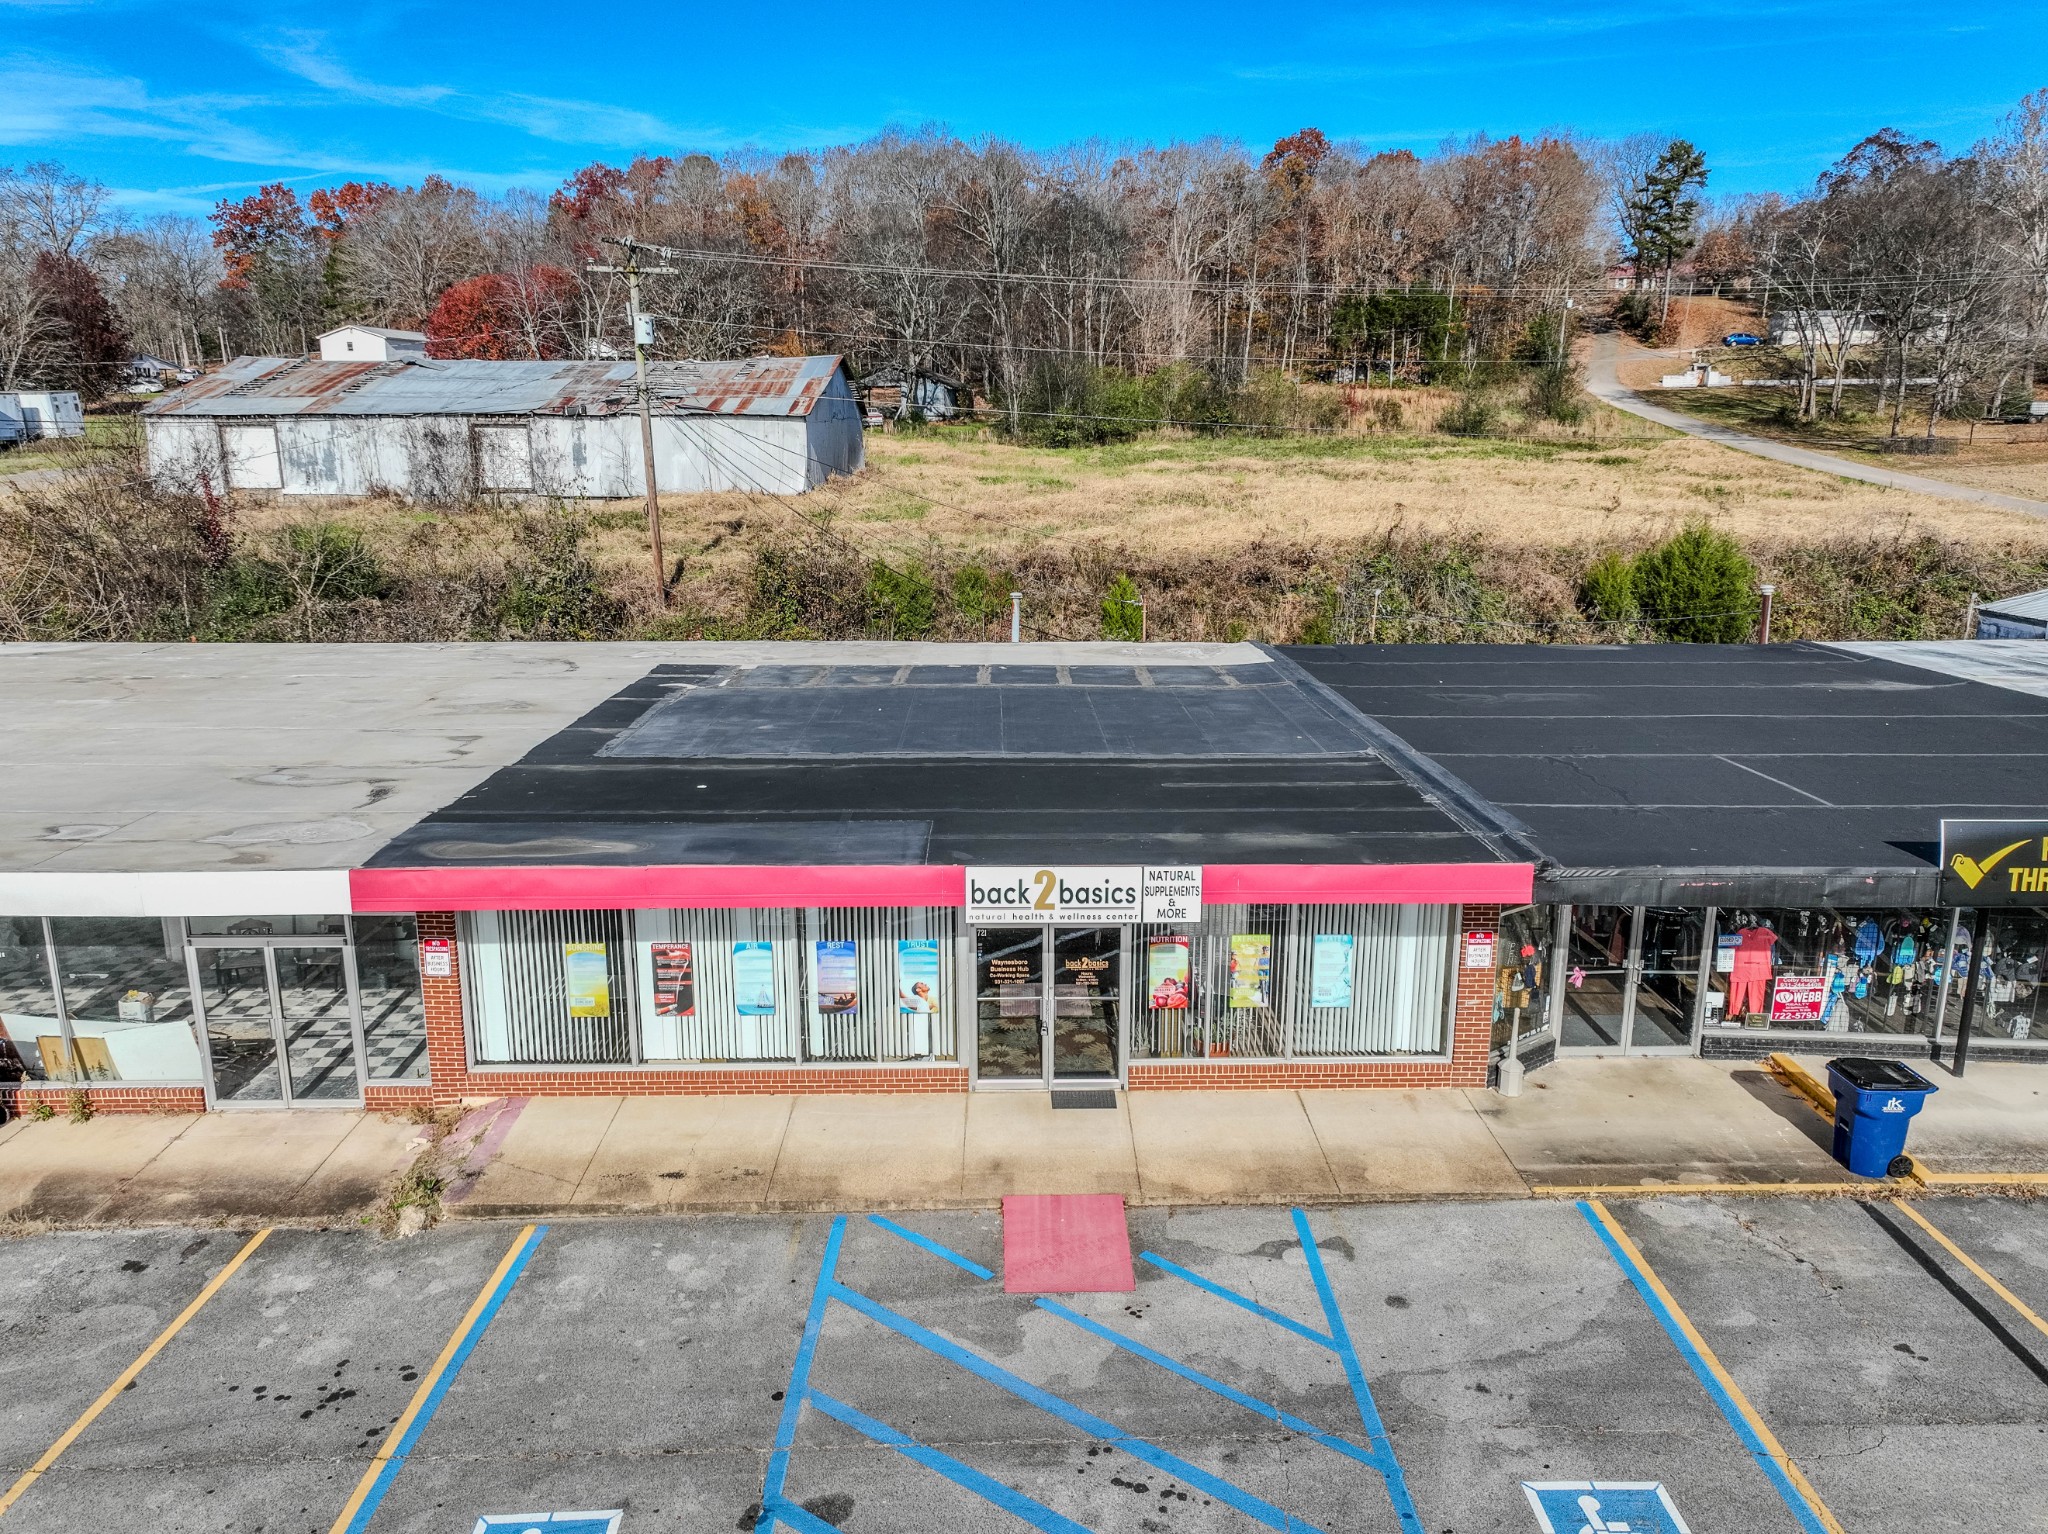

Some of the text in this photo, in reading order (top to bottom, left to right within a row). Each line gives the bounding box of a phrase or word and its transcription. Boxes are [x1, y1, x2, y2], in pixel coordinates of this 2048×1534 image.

[1149, 871, 1196, 881] NATURAL
[1145, 886, 1200, 897] SUPPLEMENTS
[1168, 898, 1176, 907] &
[1157, 908, 1187, 918] MORE
[746, 942, 759, 950] AIR
[1794, 992, 1821, 1003] WEBB
[1774, 1011, 1818, 1020] 722-5793
